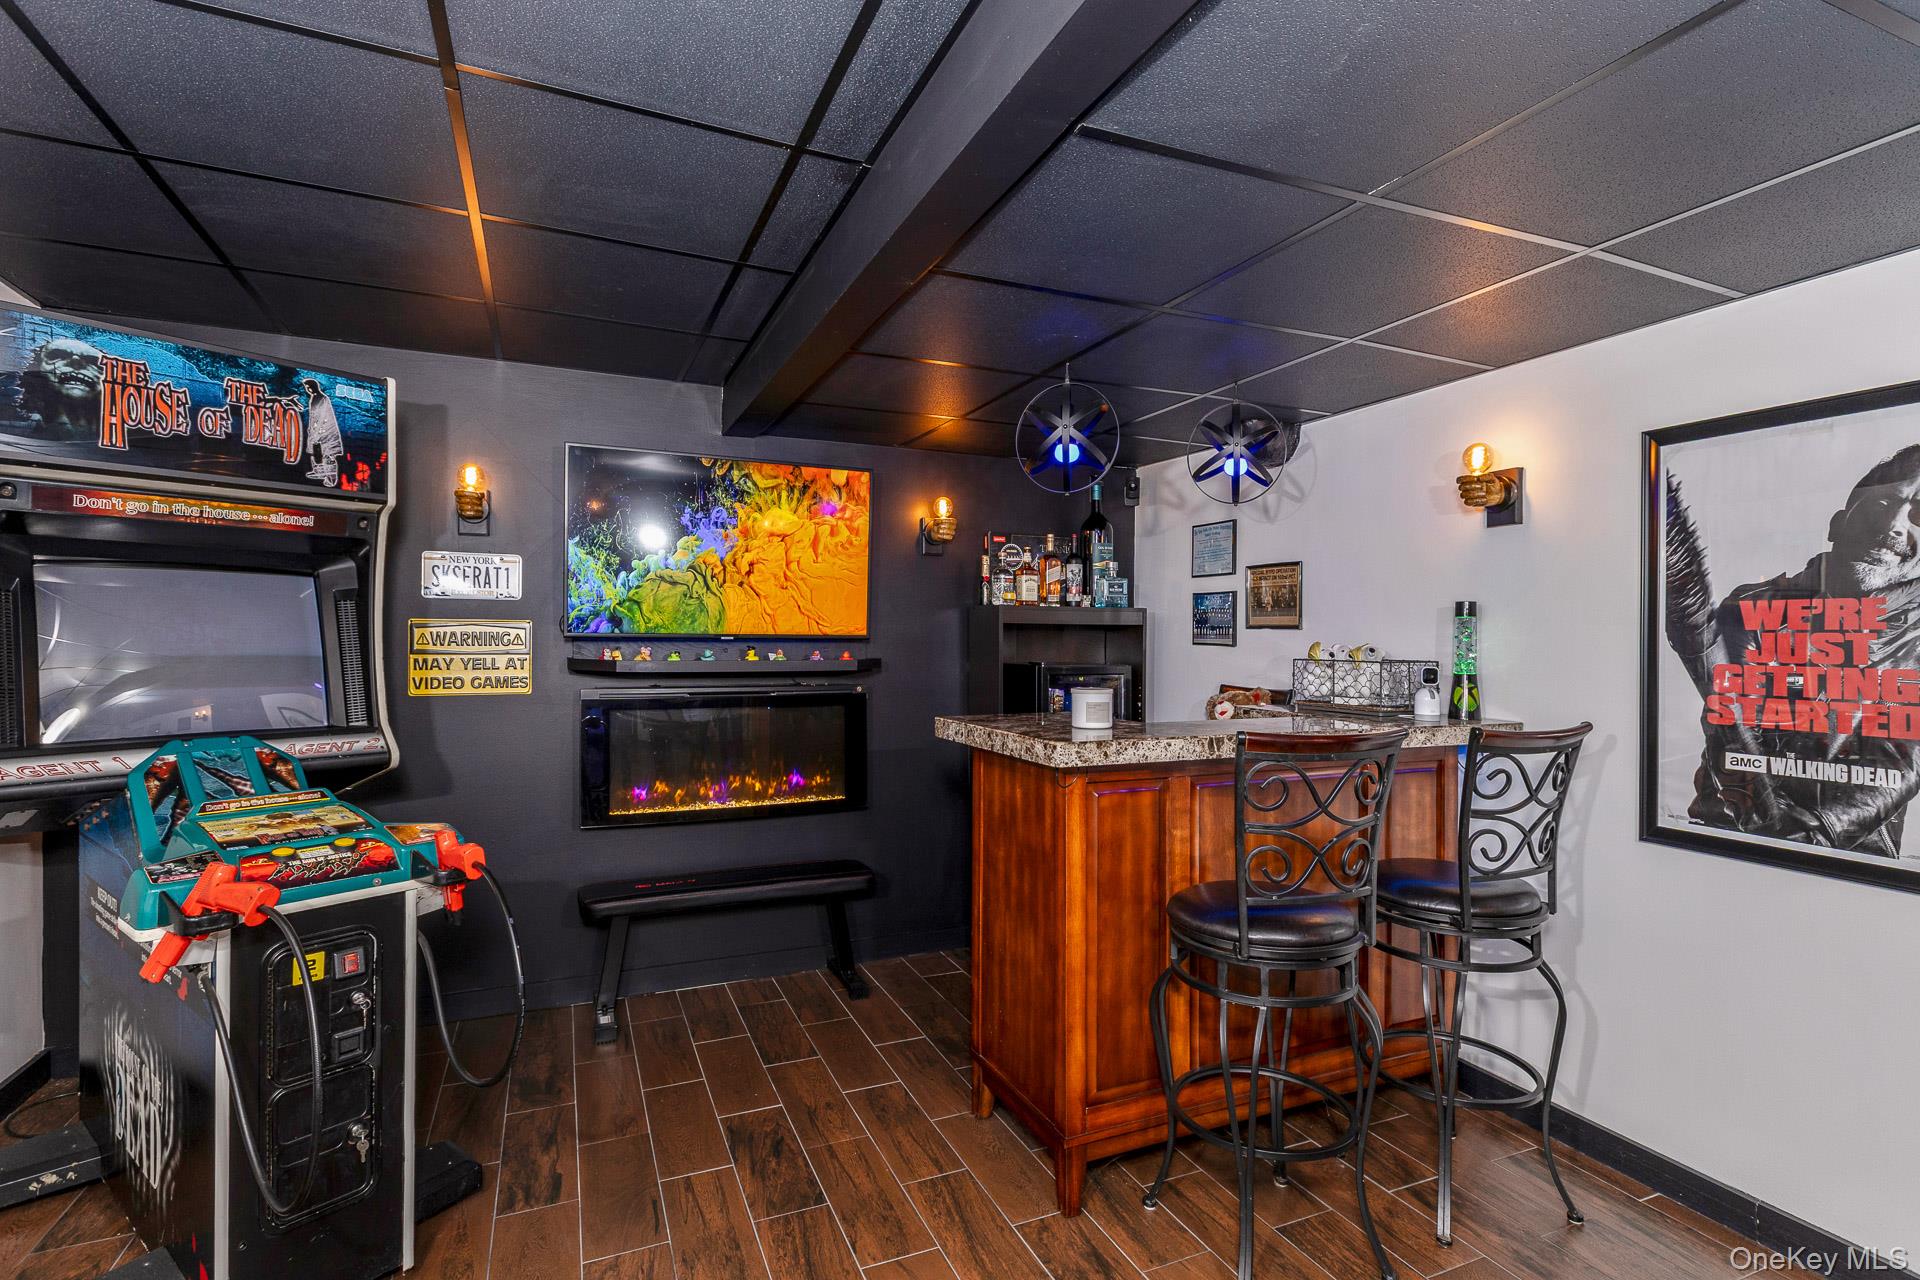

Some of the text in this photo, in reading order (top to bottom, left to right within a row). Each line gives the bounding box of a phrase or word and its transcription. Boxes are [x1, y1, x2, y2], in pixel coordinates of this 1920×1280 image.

[336, 384, 373, 402] SEGA
[99, 355, 303, 464] THE HOUSE OF THE DEAD
[73, 494, 123, 510] Don't
[126, 501, 149, 515] go
[152, 500, 169, 514] in
[172, 502, 200, 517] the
[449, 555, 497, 566] NEW YORK
[1739, 597, 1888, 630] WE'RE
[430, 631, 512, 647] WARNING
[1744, 632, 1878, 665] JUST
[413, 657, 528, 671] MAY YELL AT
[412, 675, 529, 690] VIDEO GAMES
[1712, 663, 1920, 703] GETTING
[1706, 695, 1920, 740] STARTED
[284, 737, 382, 757] AGENT 2
[0, 756, 132, 781] AGENT 1
[1770, 757, 1902, 788] WALKING DEAD
